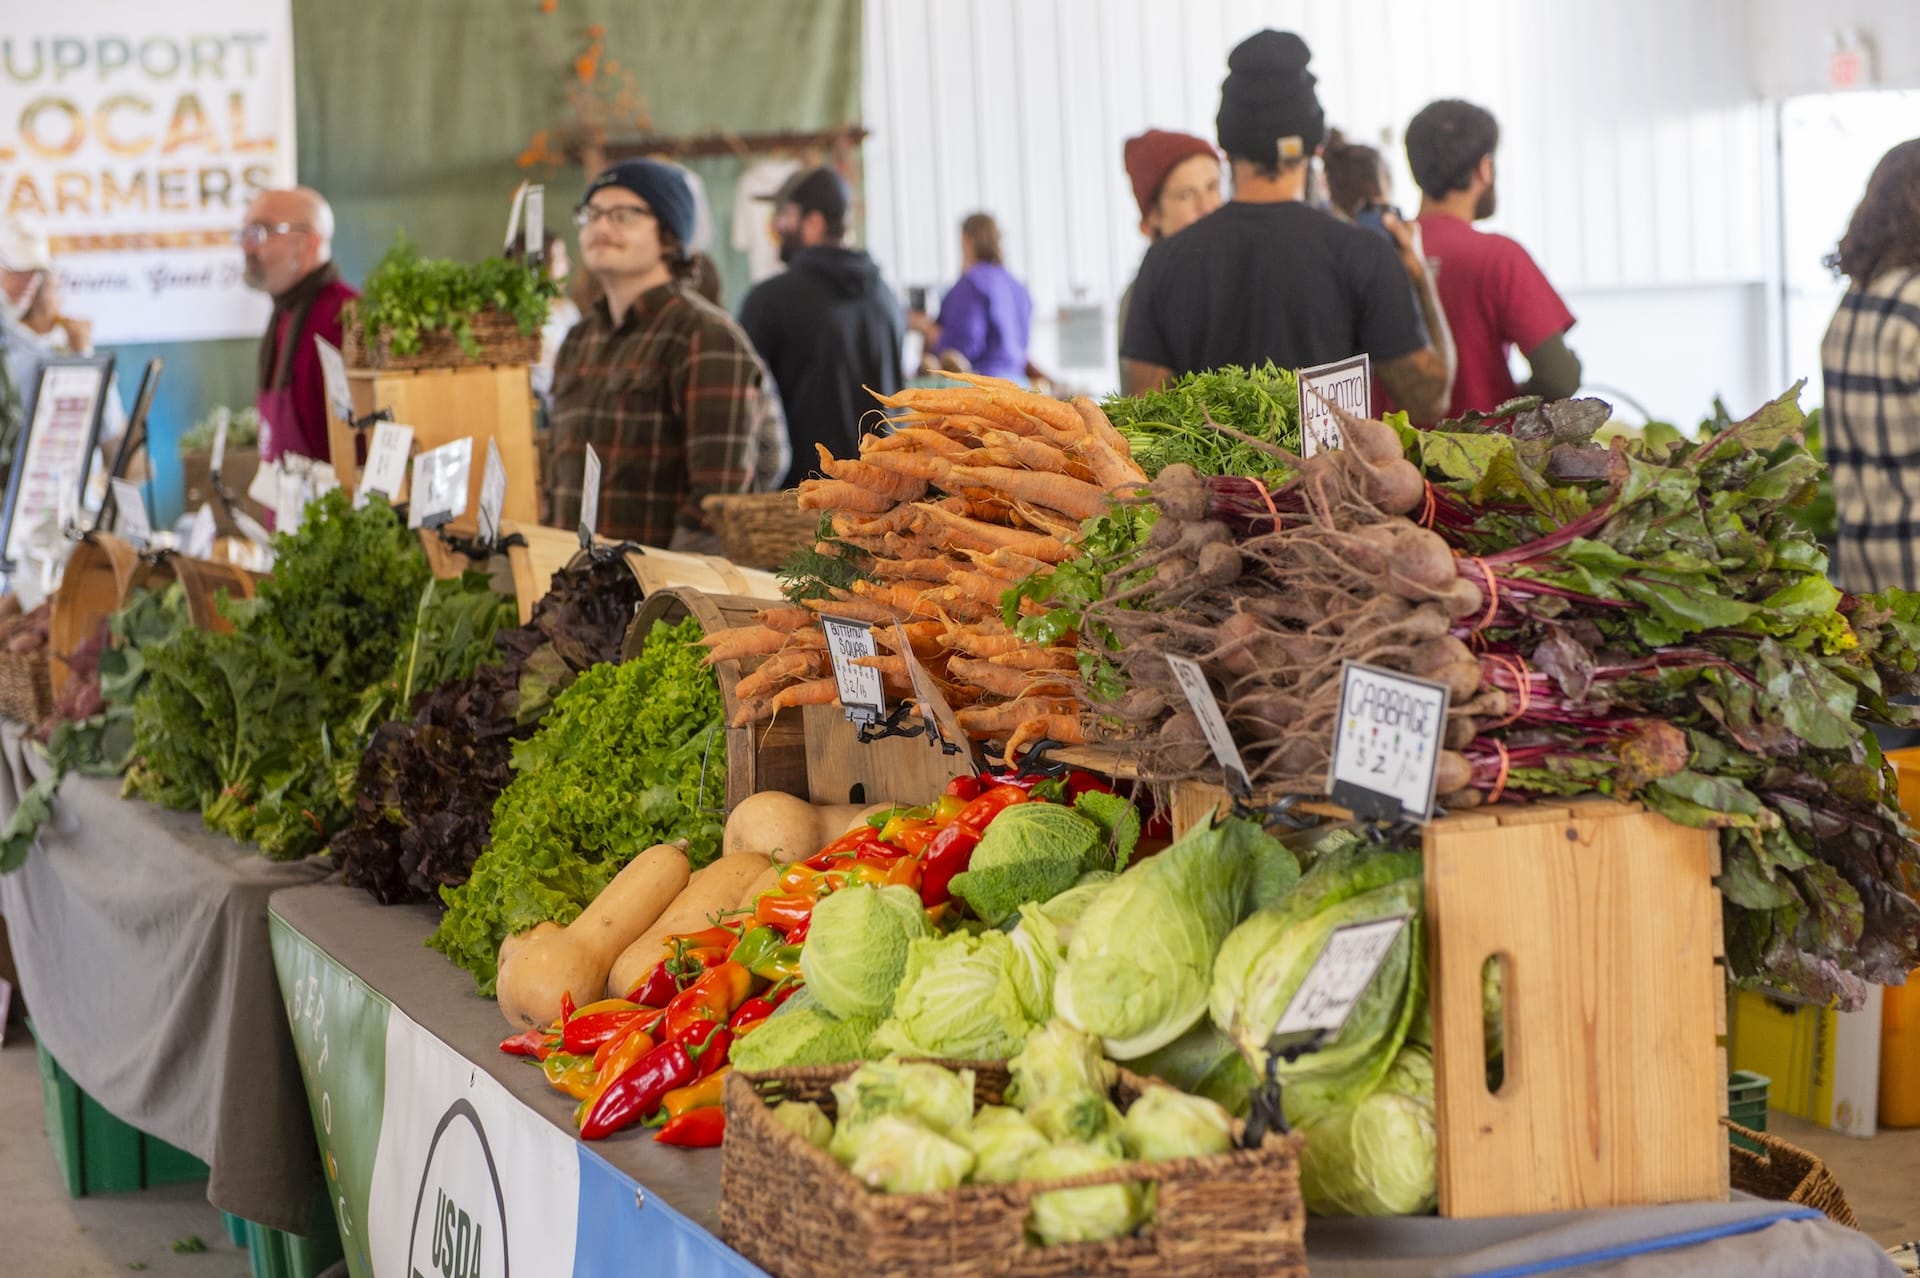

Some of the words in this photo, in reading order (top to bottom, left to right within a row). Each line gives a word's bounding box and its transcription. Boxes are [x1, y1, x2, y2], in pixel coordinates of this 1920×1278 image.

[0, 33, 267, 82] UPPORT
[0, 163, 273, 215] ARMERS
[839, 638, 868, 658] SQUASH
[1348, 677, 1437, 738] CABBAGE
[432, 1186, 482, 1278] USDA
